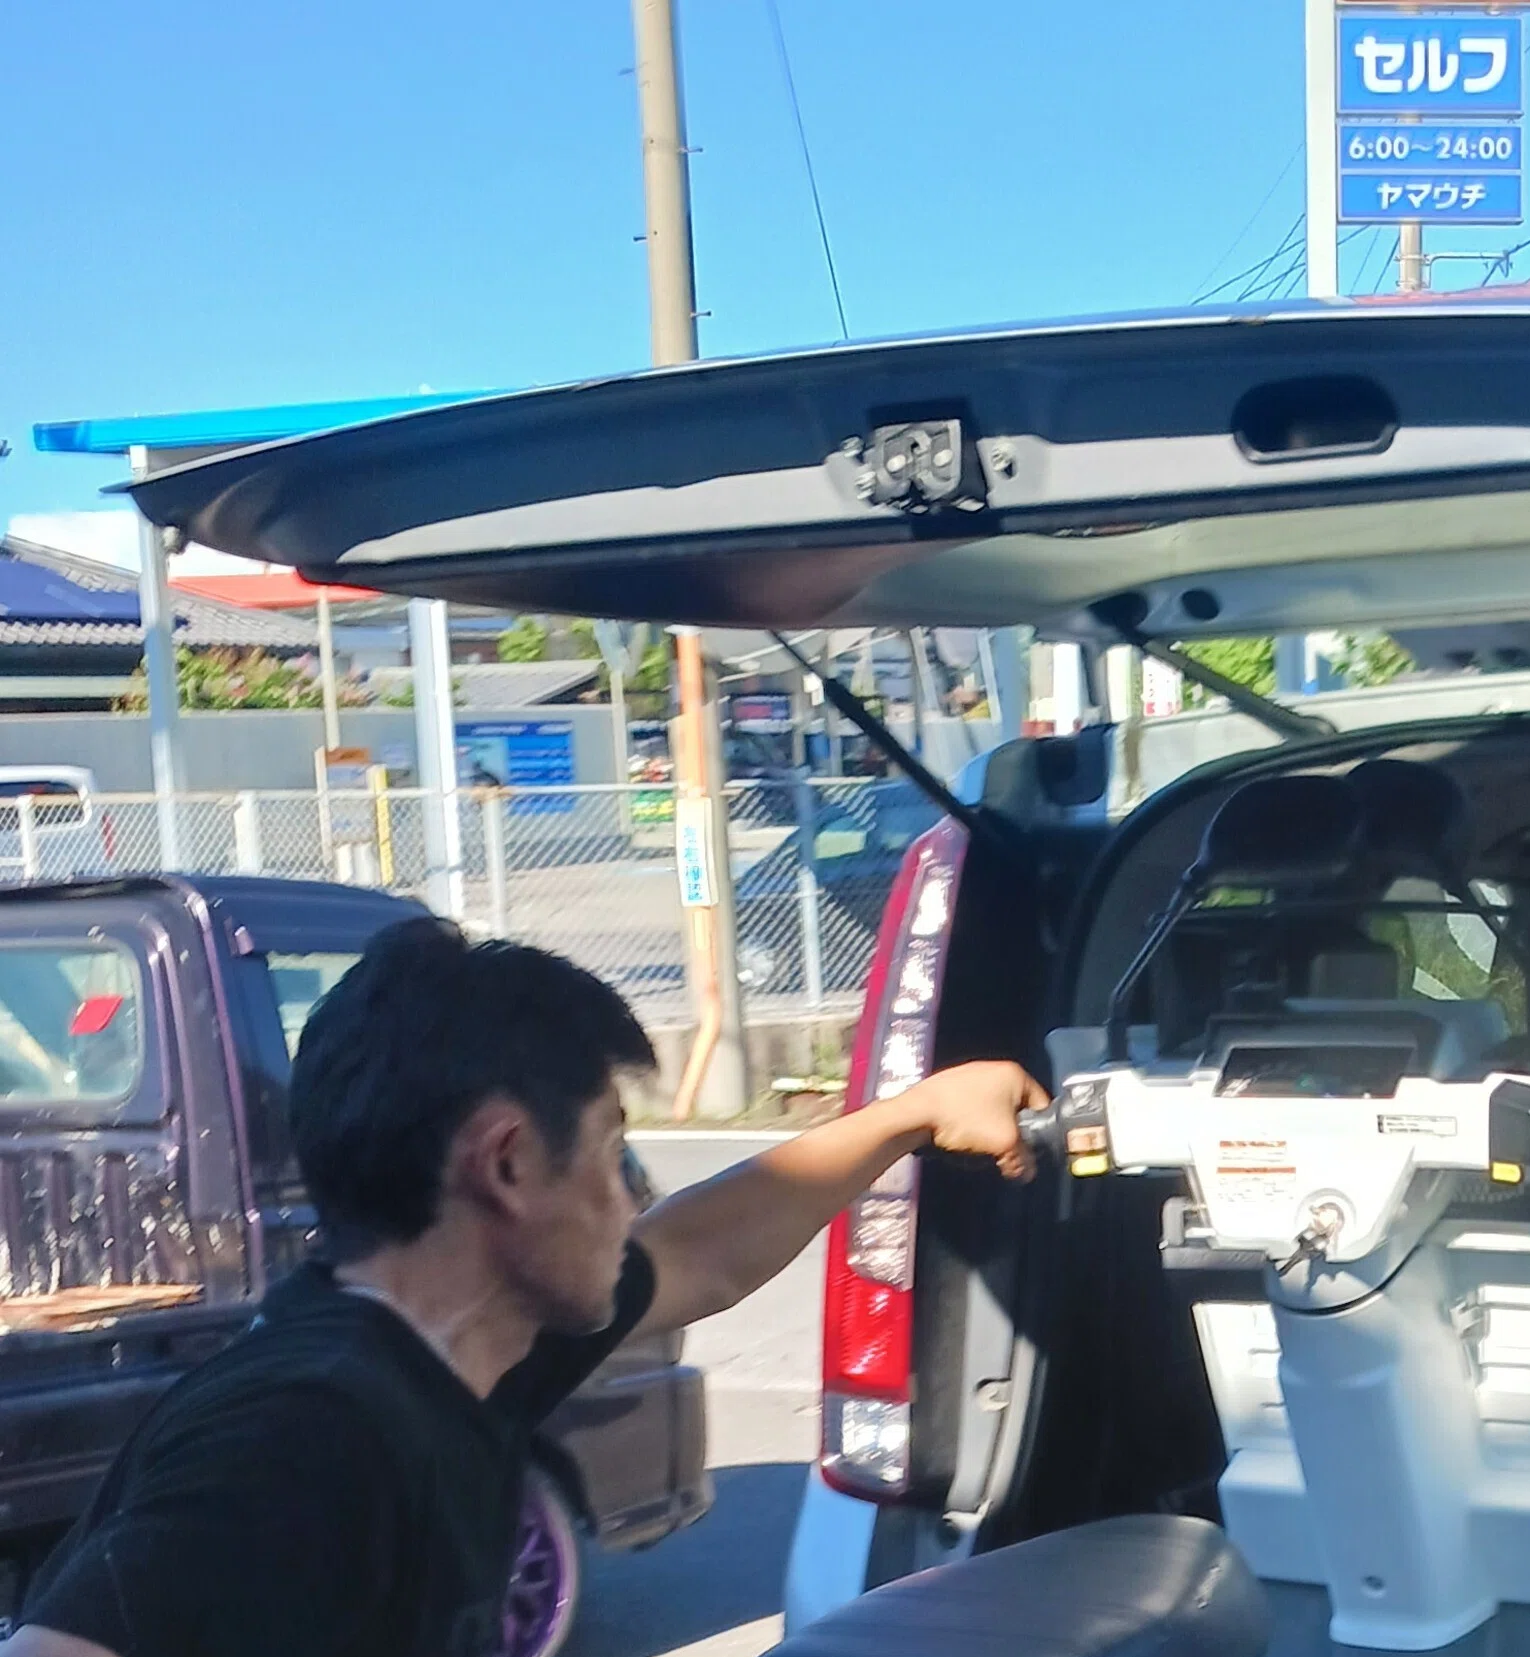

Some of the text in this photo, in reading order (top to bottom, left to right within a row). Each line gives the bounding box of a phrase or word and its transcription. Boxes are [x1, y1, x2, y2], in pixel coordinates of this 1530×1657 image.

[1354, 36, 1507, 93] セルフ
[1377, 182, 1487, 210] ヤマウチ
